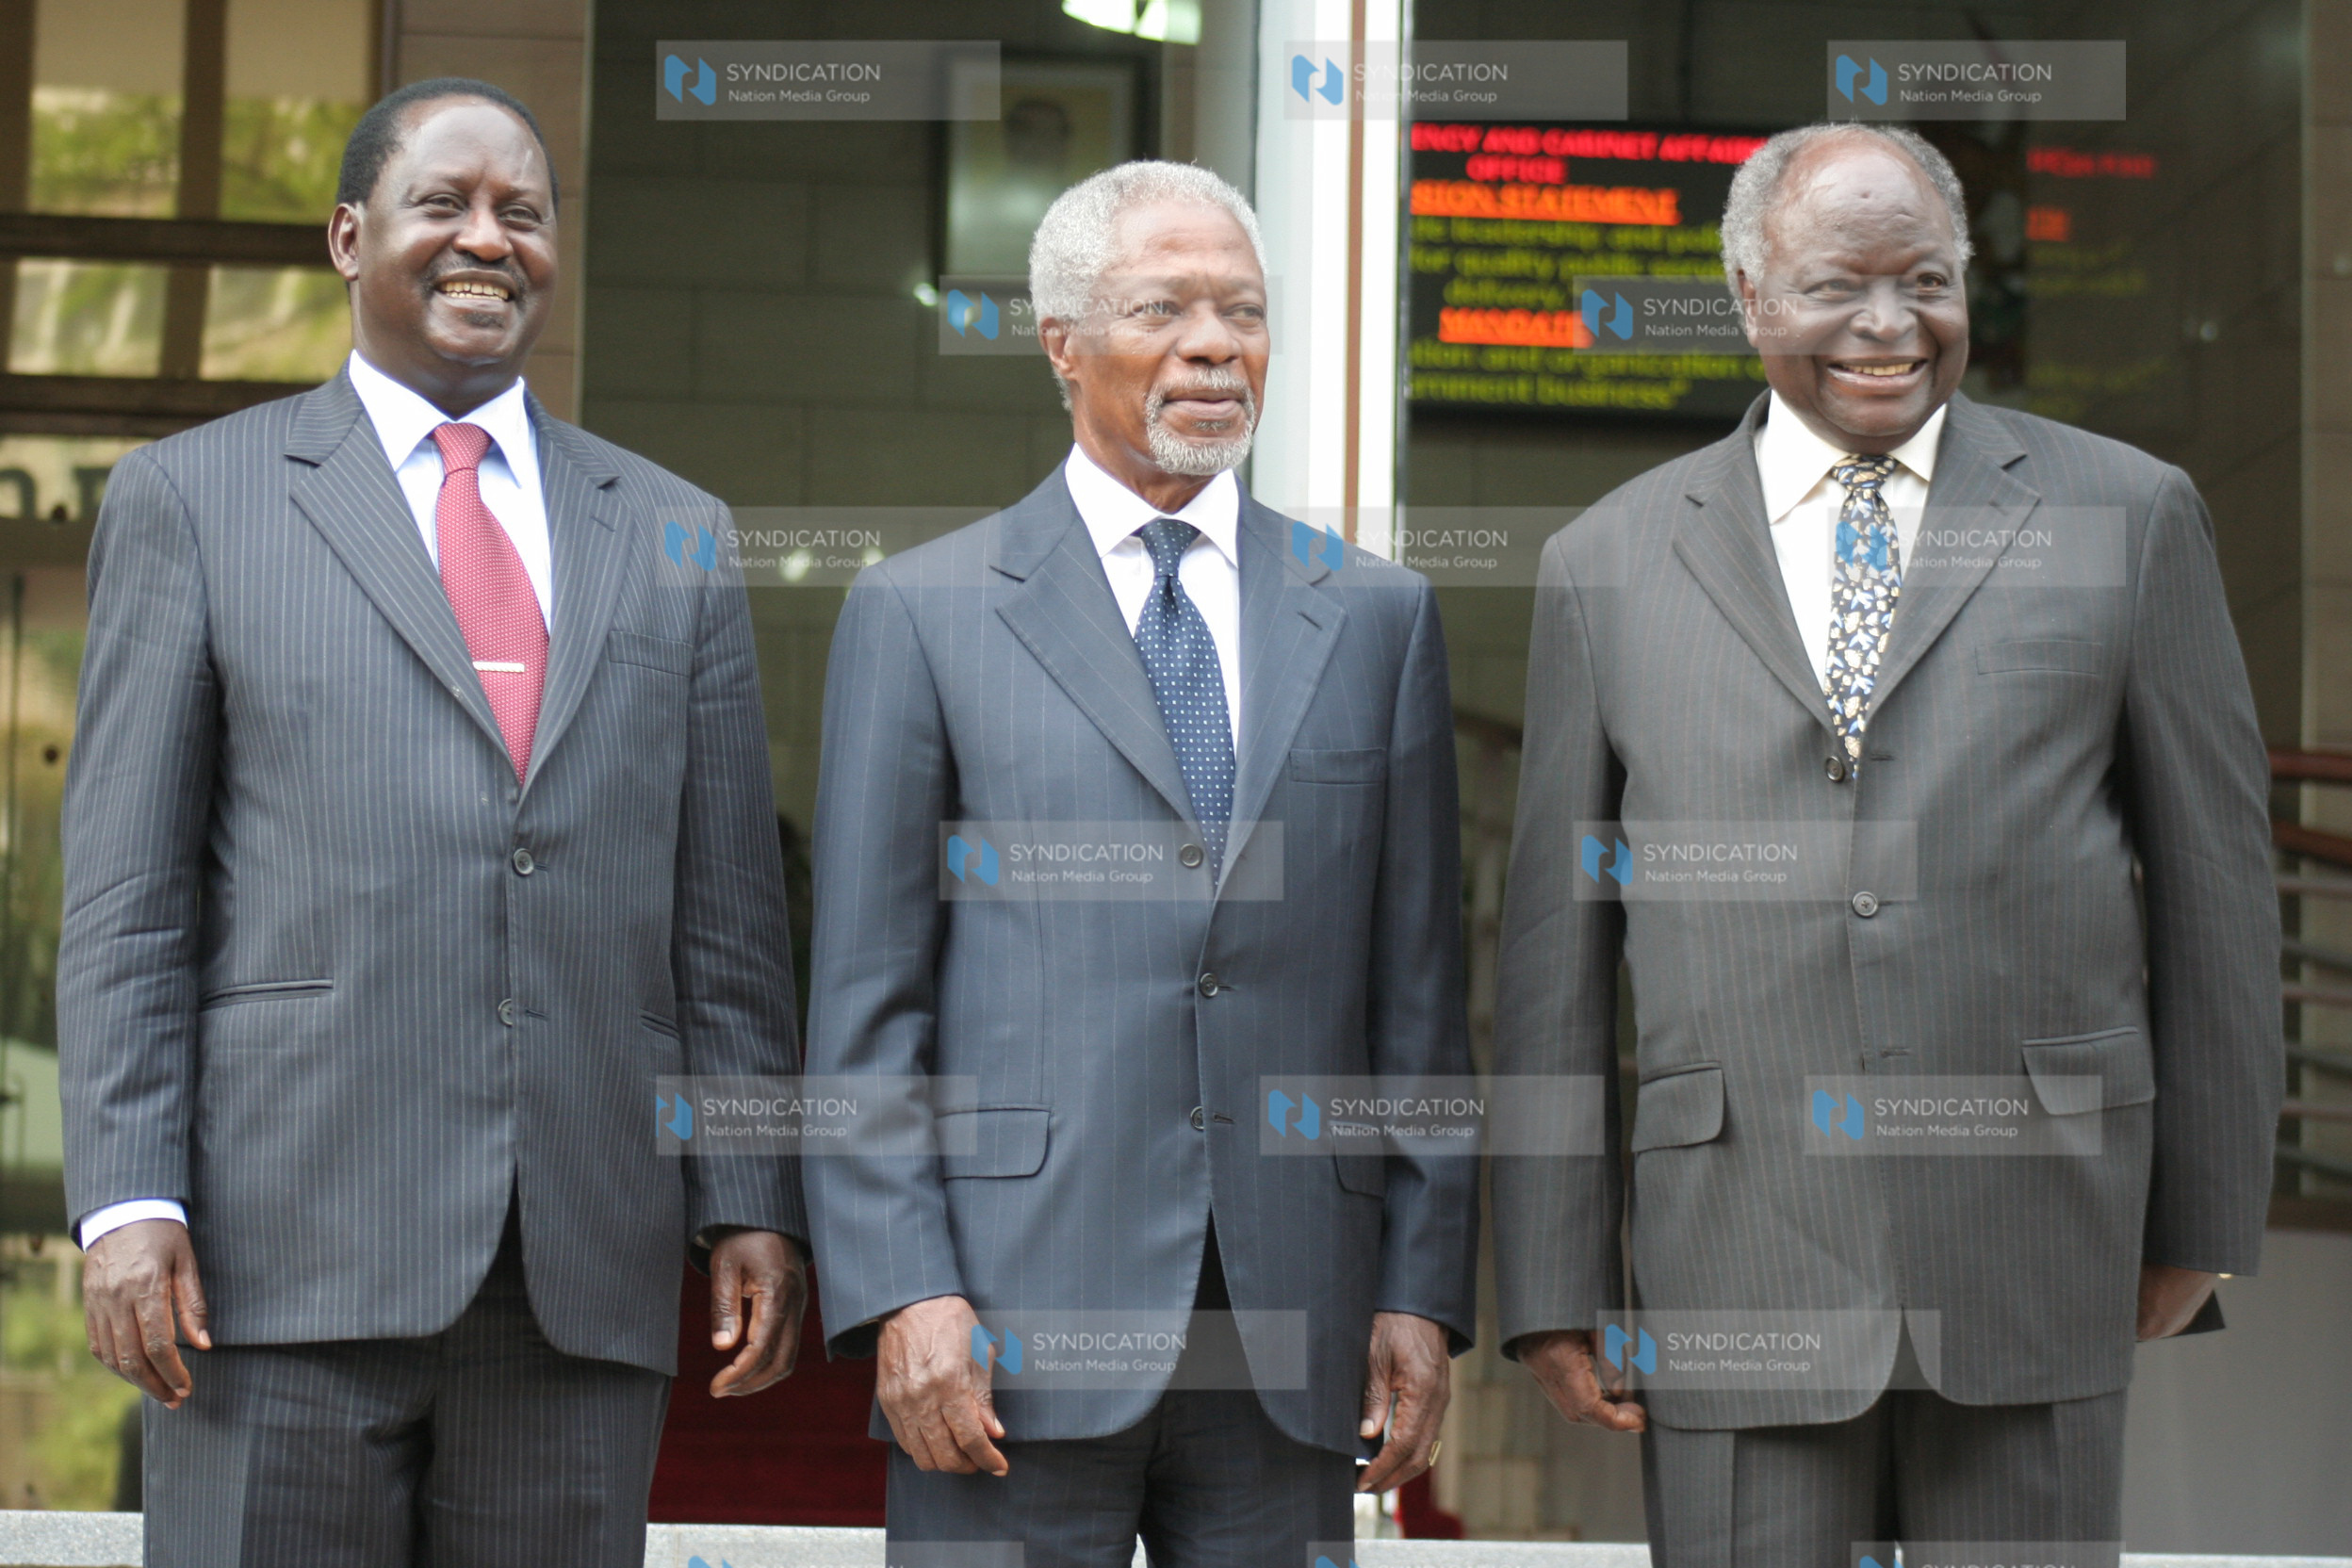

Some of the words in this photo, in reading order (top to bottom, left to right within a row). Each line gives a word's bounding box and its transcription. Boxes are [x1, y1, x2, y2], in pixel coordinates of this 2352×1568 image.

[1483, 126, 1542, 155] AND
[1466, 153, 1568, 184] OFFICE
[1500, 183, 1681, 224] STATEMENT
